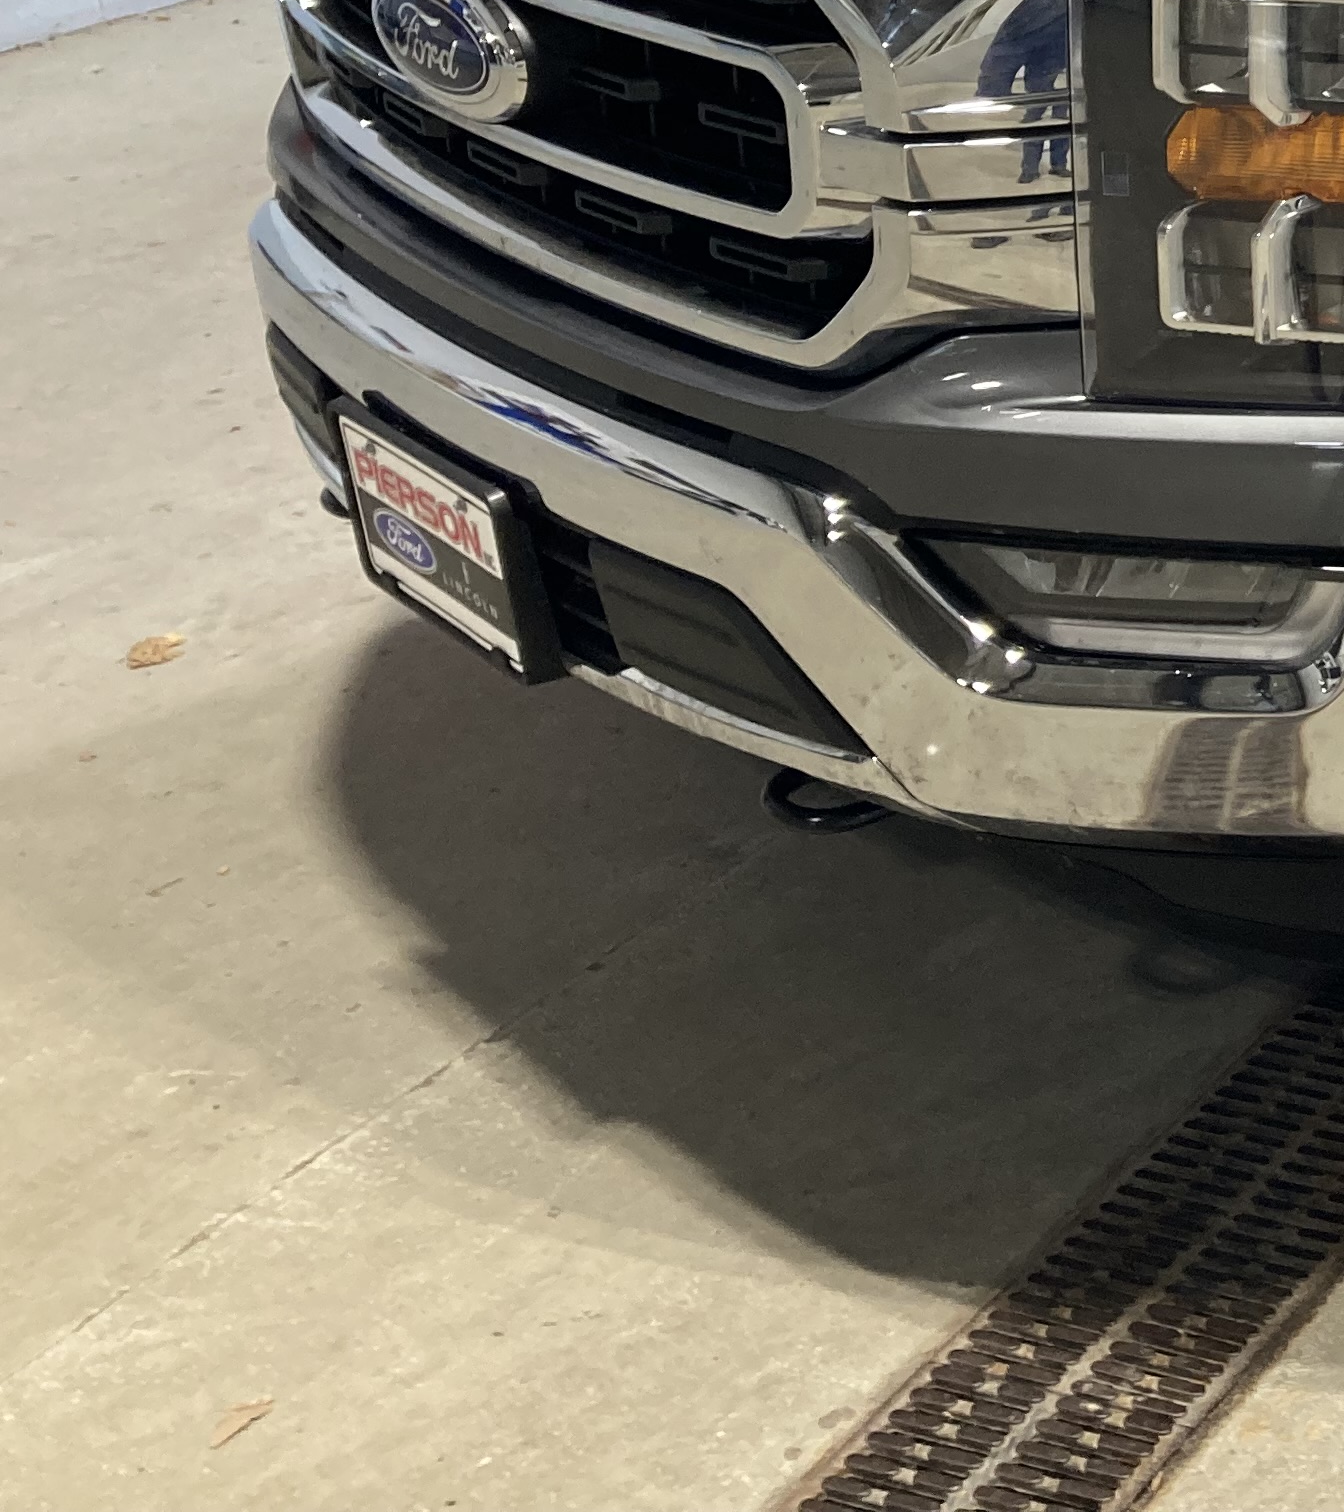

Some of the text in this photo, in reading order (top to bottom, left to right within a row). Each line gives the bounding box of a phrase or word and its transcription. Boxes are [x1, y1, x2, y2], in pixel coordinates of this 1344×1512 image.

[395, 2, 459, 79] Ford
[354, 450, 484, 560] PIERSON
[386, 517, 424, 562] Ford
